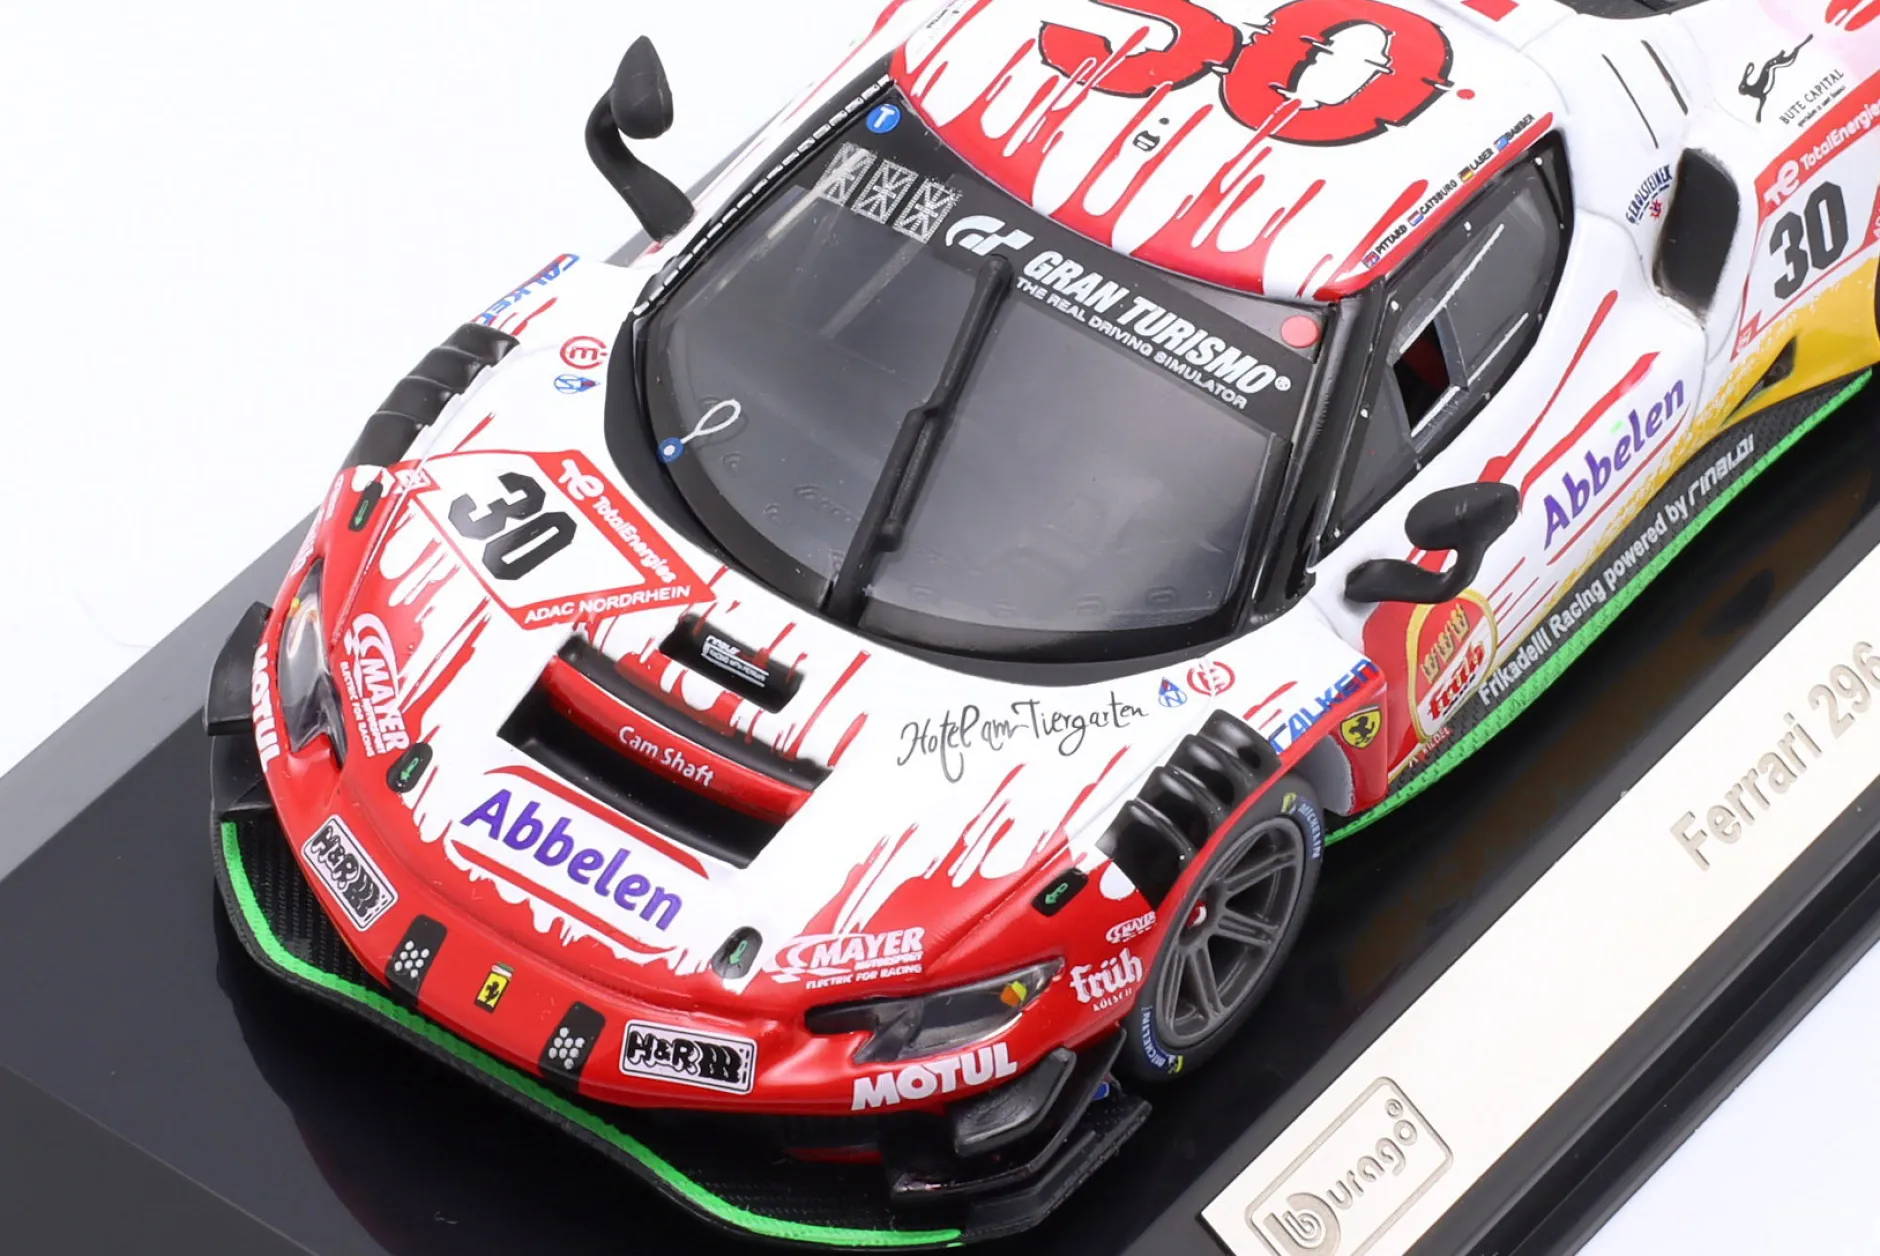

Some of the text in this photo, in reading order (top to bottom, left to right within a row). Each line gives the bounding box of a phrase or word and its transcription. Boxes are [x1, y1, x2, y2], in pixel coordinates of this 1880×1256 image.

[1779, 100, 1806, 125] BUTE
[1804, 69, 1844, 103] CAPITAL
[1800, 97, 1880, 171] TotalEnergie
[1023, 250, 1129, 314] GRAN
[1376, 224, 1407, 254] PITTARD
[1769, 181, 1849, 300] 30
[1016, 277, 1247, 410] THE REAL DRIVING SIMULATOR
[1543, 379, 1684, 551] Abbelen
[448, 471, 577, 580] 30
[592, 496, 677, 585] TotalEnergies
[523, 585, 691, 625] ADAC NORDRHEIN
[1478, 624, 1552, 706] Frikadelli
[1550, 580, 1607, 638] Racing
[1603, 513, 1668, 590] powered
[1666, 496, 1688, 525] by
[252, 642, 281, 773] MOTUL
[352, 702, 364, 721] FOR
[360, 658, 411, 752] MAYER
[897, 705, 980, 783] Hotel
[1012, 690, 1150, 757] Tiergarten
[618, 725, 714, 787] Cam Shaft
[1670, 641, 1880, 872] Ferrari 296
[460, 788, 683, 932] Abbelen
[810, 926, 925, 969] MAYER
[856, 971, 878, 982] FOR
[880, 964, 922, 979] RACING
[851, 1041, 1018, 1111] MOTUL
